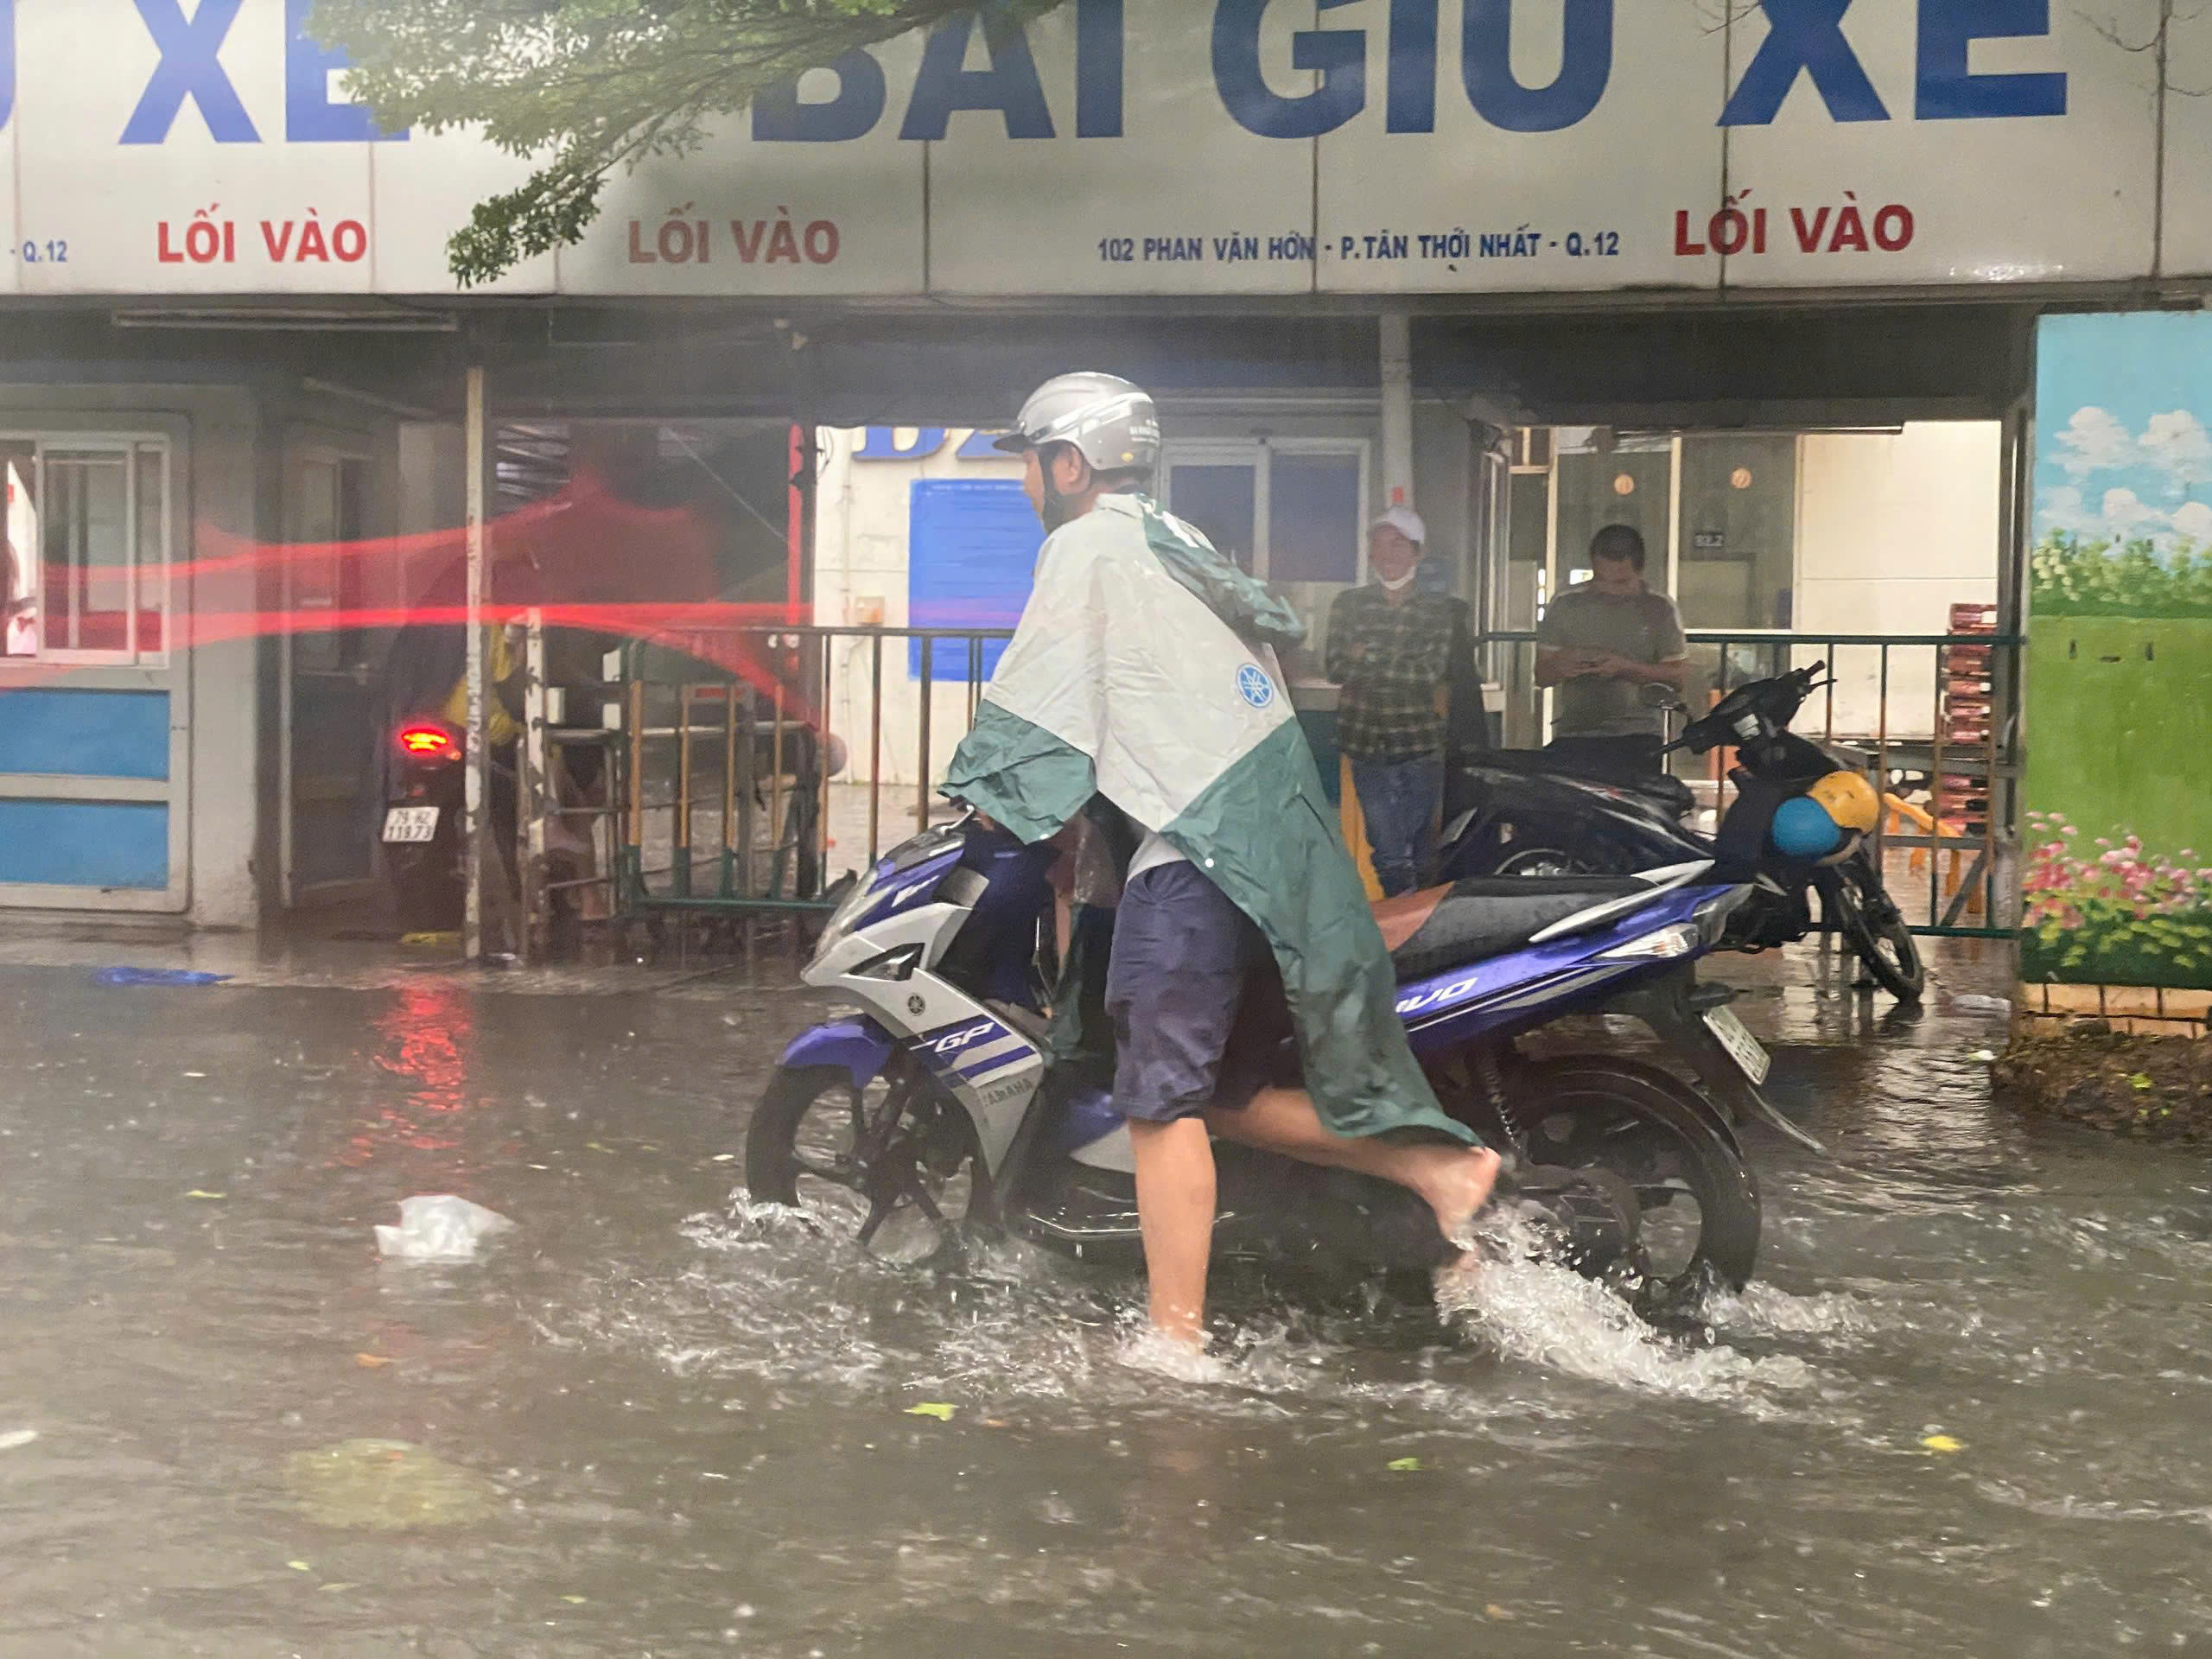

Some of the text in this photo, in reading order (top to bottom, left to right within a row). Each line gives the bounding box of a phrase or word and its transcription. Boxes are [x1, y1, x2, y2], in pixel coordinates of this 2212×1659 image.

[1715, 0, 2067, 126] XE
[23, 240, 68, 263] Q.12
[157, 202, 367, 264] LỐI VÀO
[628, 200, 841, 264] LỐI VÀO
[1098, 238, 1134, 262] 102
[1143, 237, 1203, 261] PHAN
[1213, 230, 1259, 262] VĂN
[1479, 224, 1542, 258] NHẤT
[1565, 232, 1619, 258] Q.12
[1675, 188, 1914, 256] LỐI VÀO
[934, 1022, 995, 1053] GP
